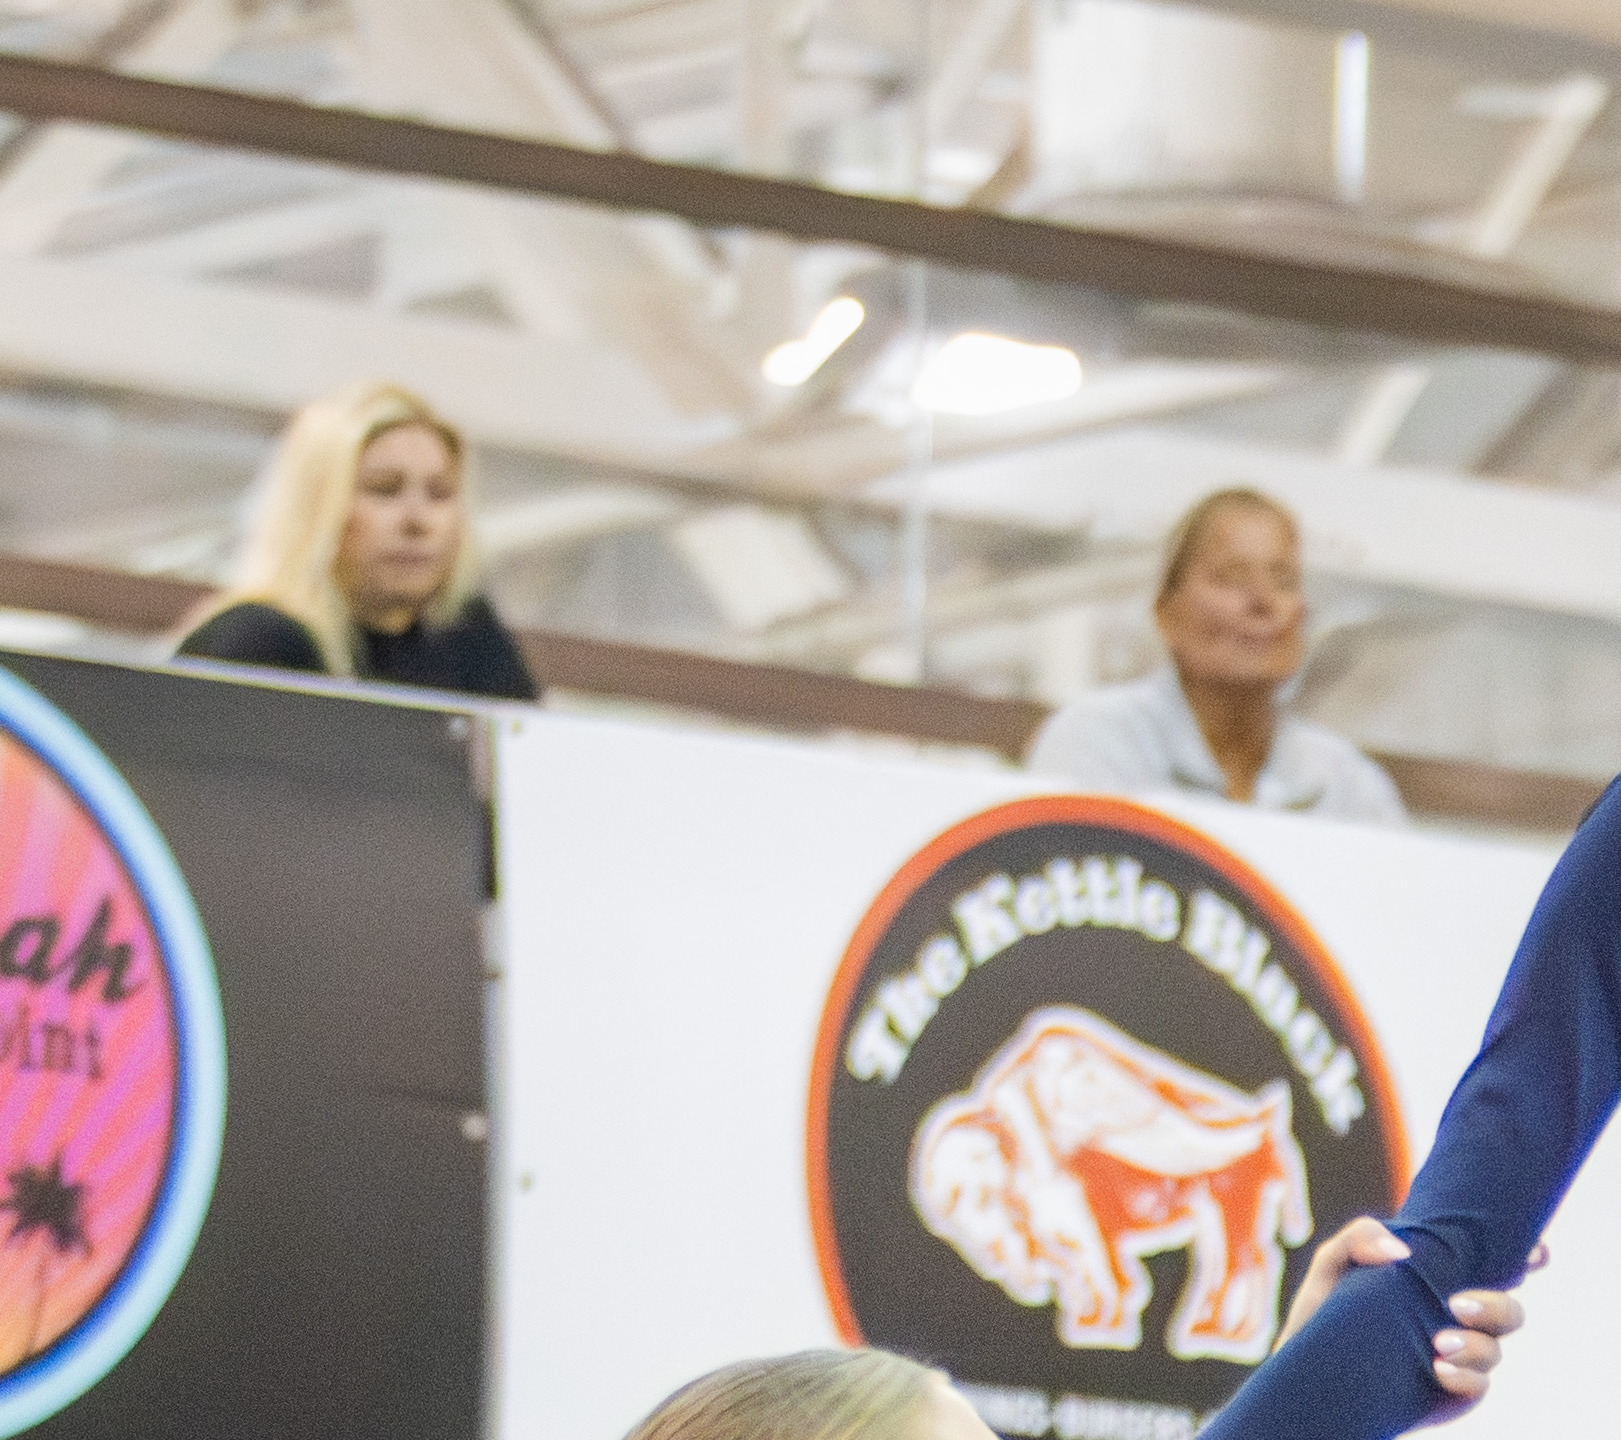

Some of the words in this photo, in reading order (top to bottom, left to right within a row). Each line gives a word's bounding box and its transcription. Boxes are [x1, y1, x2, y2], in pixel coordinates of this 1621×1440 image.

[843, 935, 968, 1086] The
[953, 856, 1181, 967] Kettle
[1183, 889, 1366, 1138] Black
